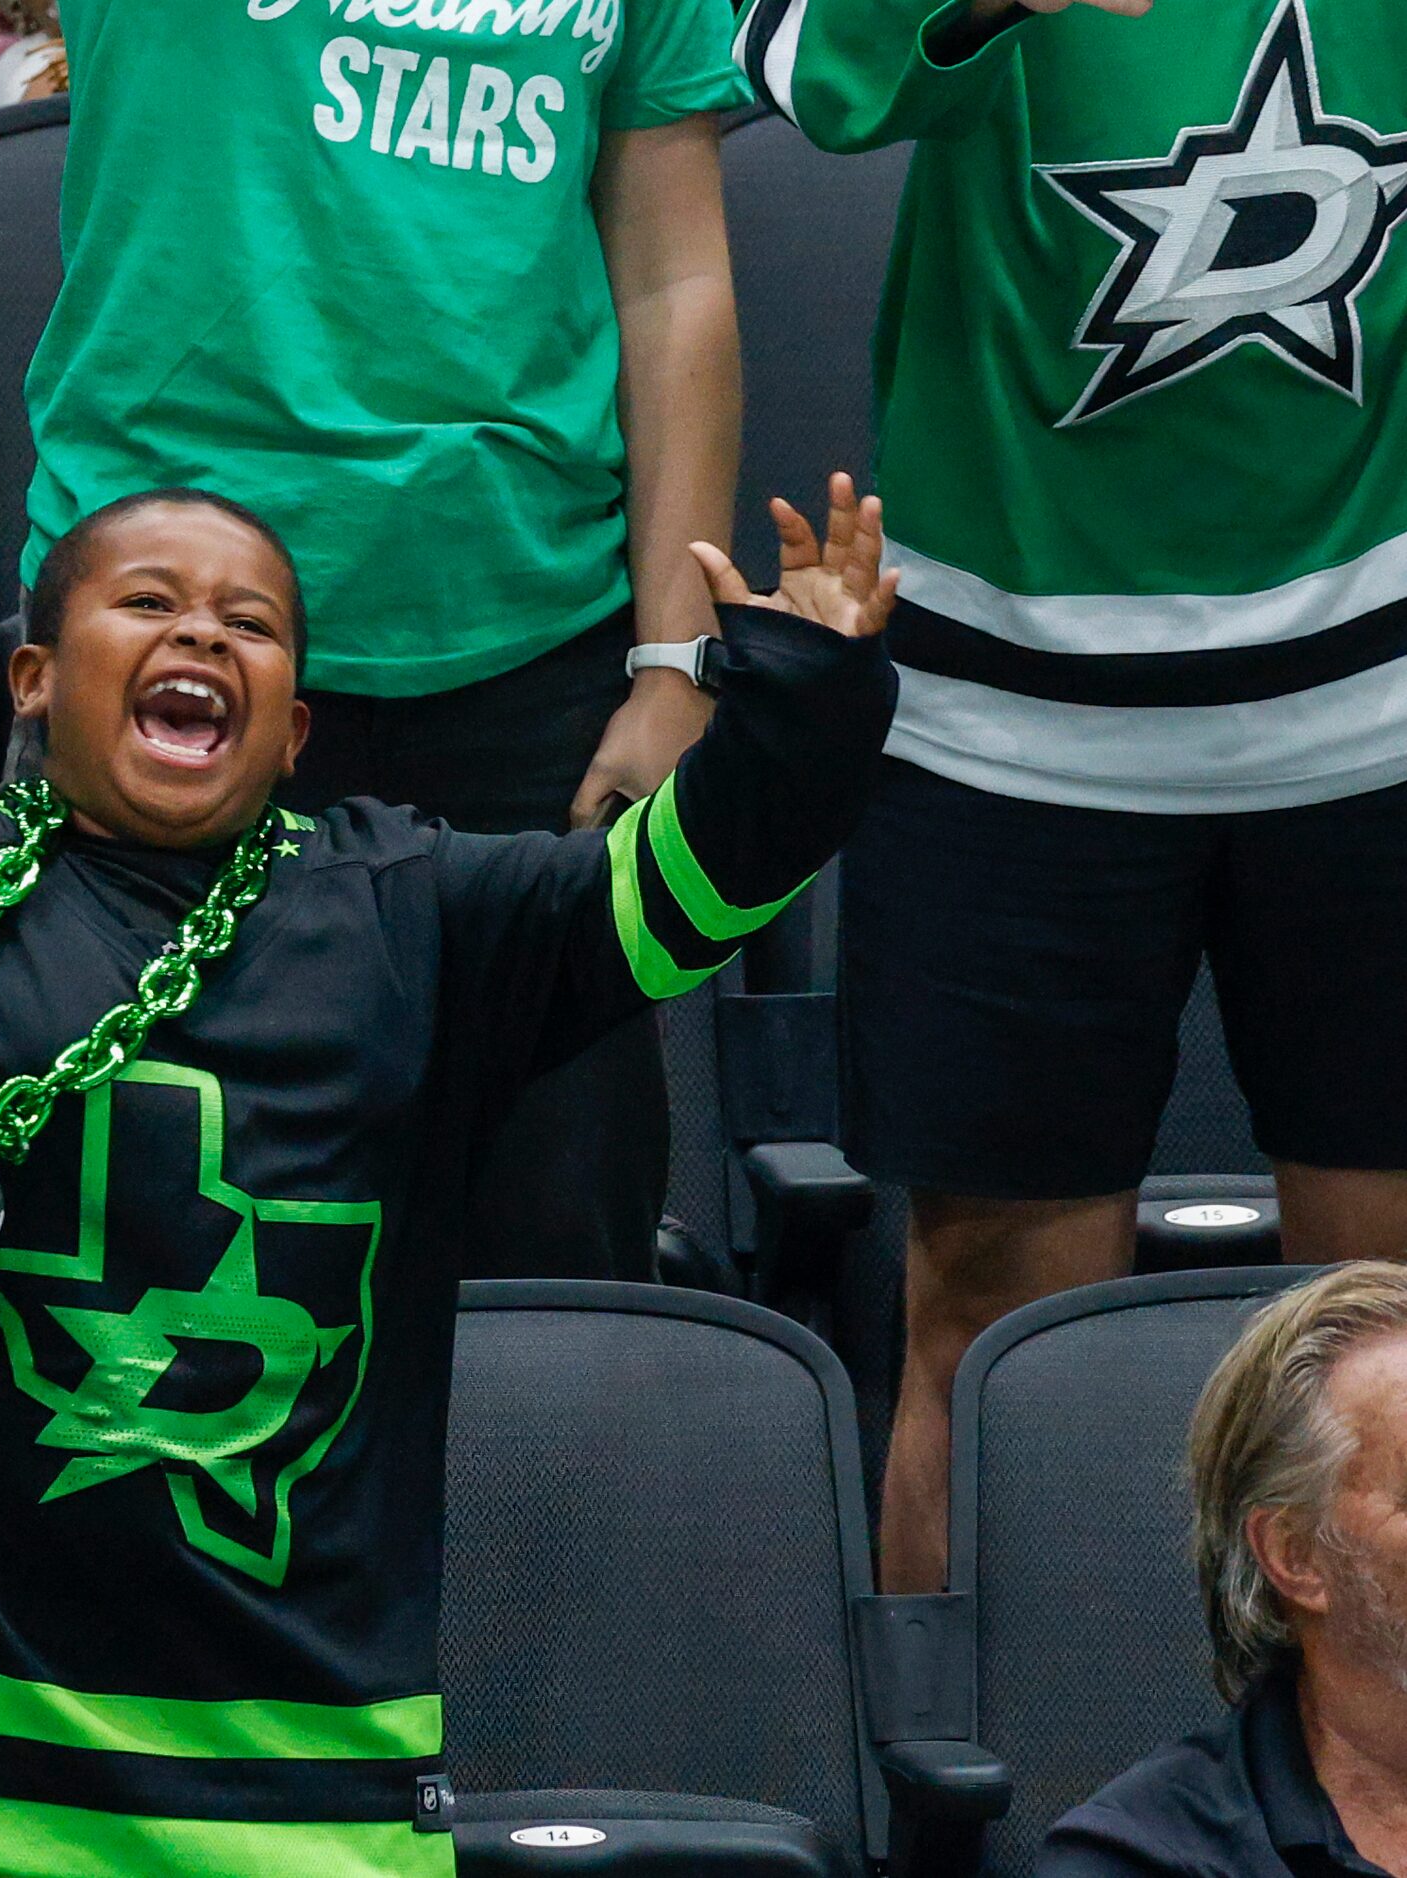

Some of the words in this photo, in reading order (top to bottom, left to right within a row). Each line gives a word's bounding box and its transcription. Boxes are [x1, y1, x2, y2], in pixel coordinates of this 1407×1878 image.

[313, 36, 565, 183] STARS
[1200, 1209, 1224, 1221] 15
[546, 1830, 570, 1842] 14
